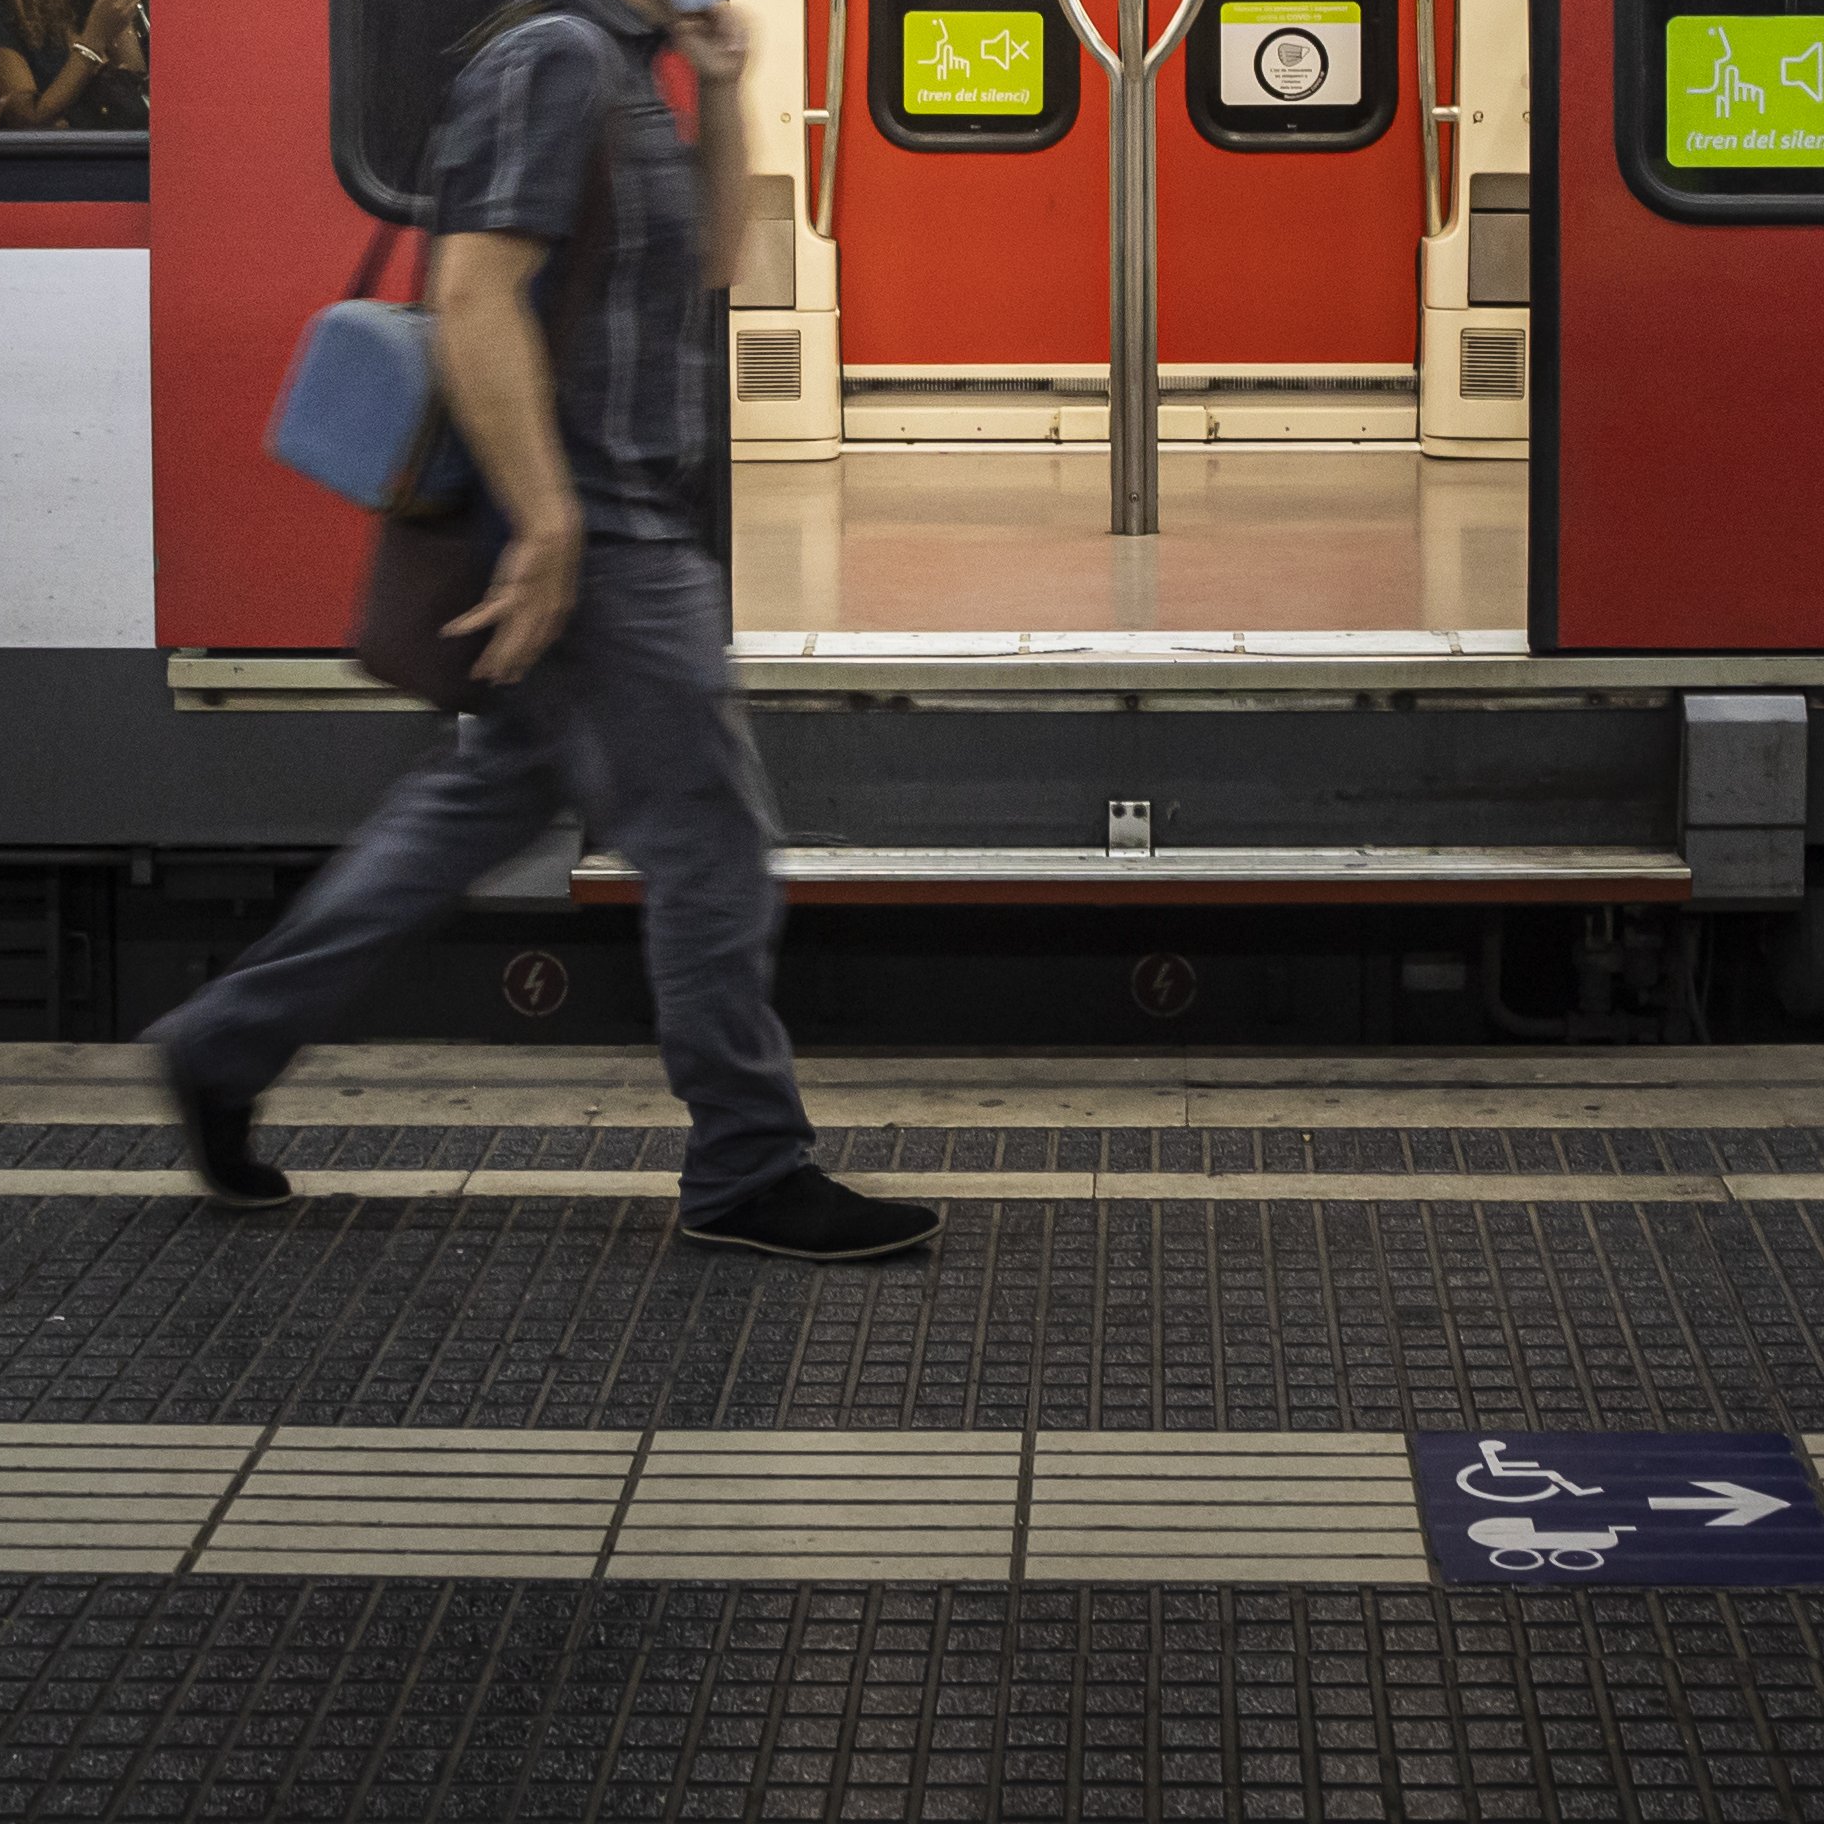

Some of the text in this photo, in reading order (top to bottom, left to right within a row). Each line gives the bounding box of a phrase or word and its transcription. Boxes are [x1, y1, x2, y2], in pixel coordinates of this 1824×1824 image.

[955, 88, 978, 102] del
[1685, 130, 1739, 152] (tren
[1742, 129, 1777, 151] del
